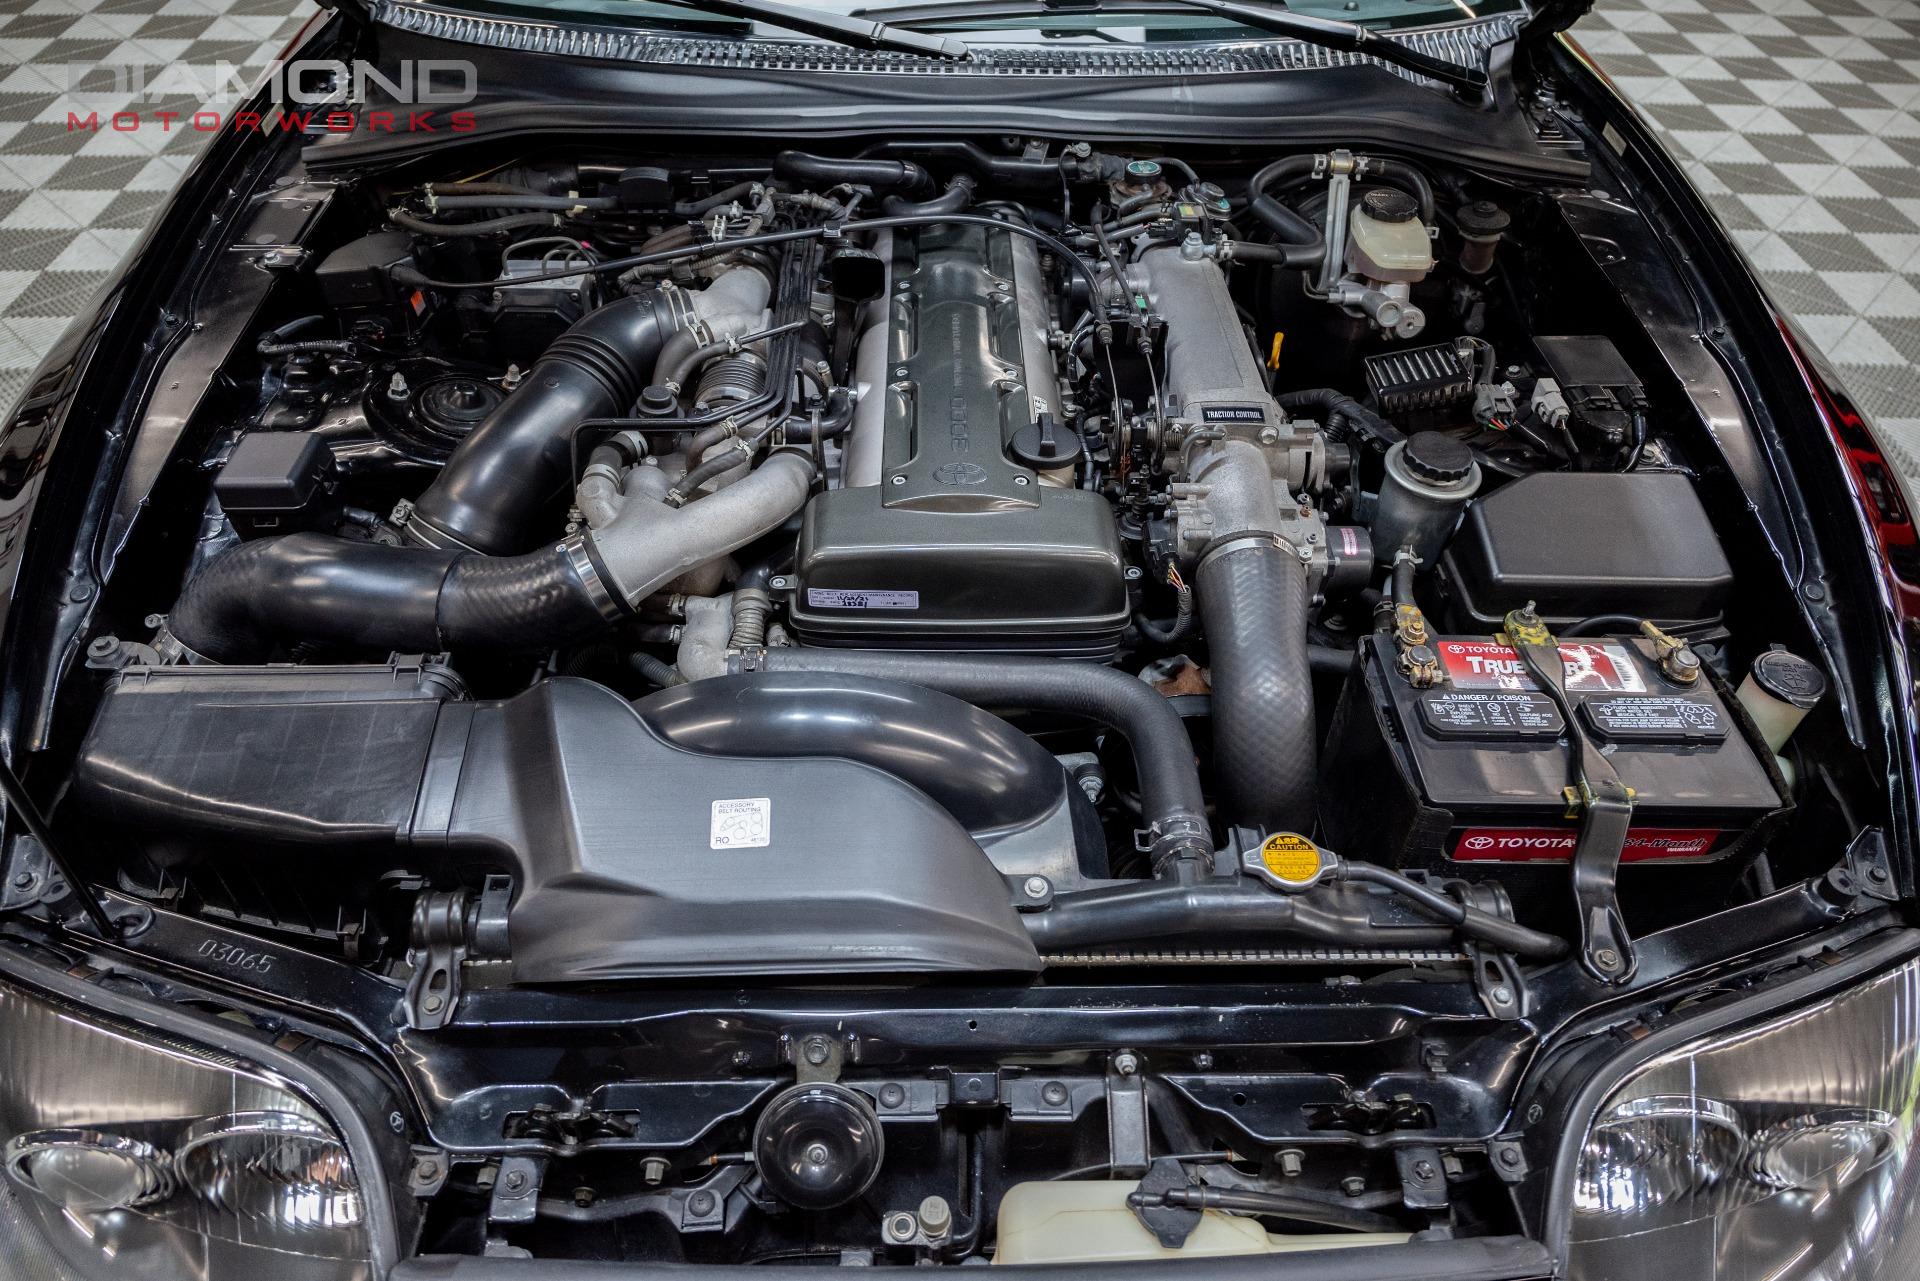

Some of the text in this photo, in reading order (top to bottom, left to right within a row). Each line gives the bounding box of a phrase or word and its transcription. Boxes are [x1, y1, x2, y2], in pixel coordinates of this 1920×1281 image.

[1236, 411, 1262, 419] CONTROL
[1466, 646, 1514, 654] TOYOTA
[718, 801, 754, 809] ACCESSORY
[715, 836, 730, 844] RO
[1498, 838, 1572, 848] TOYOTA
[198, 939, 277, 974] 03065
